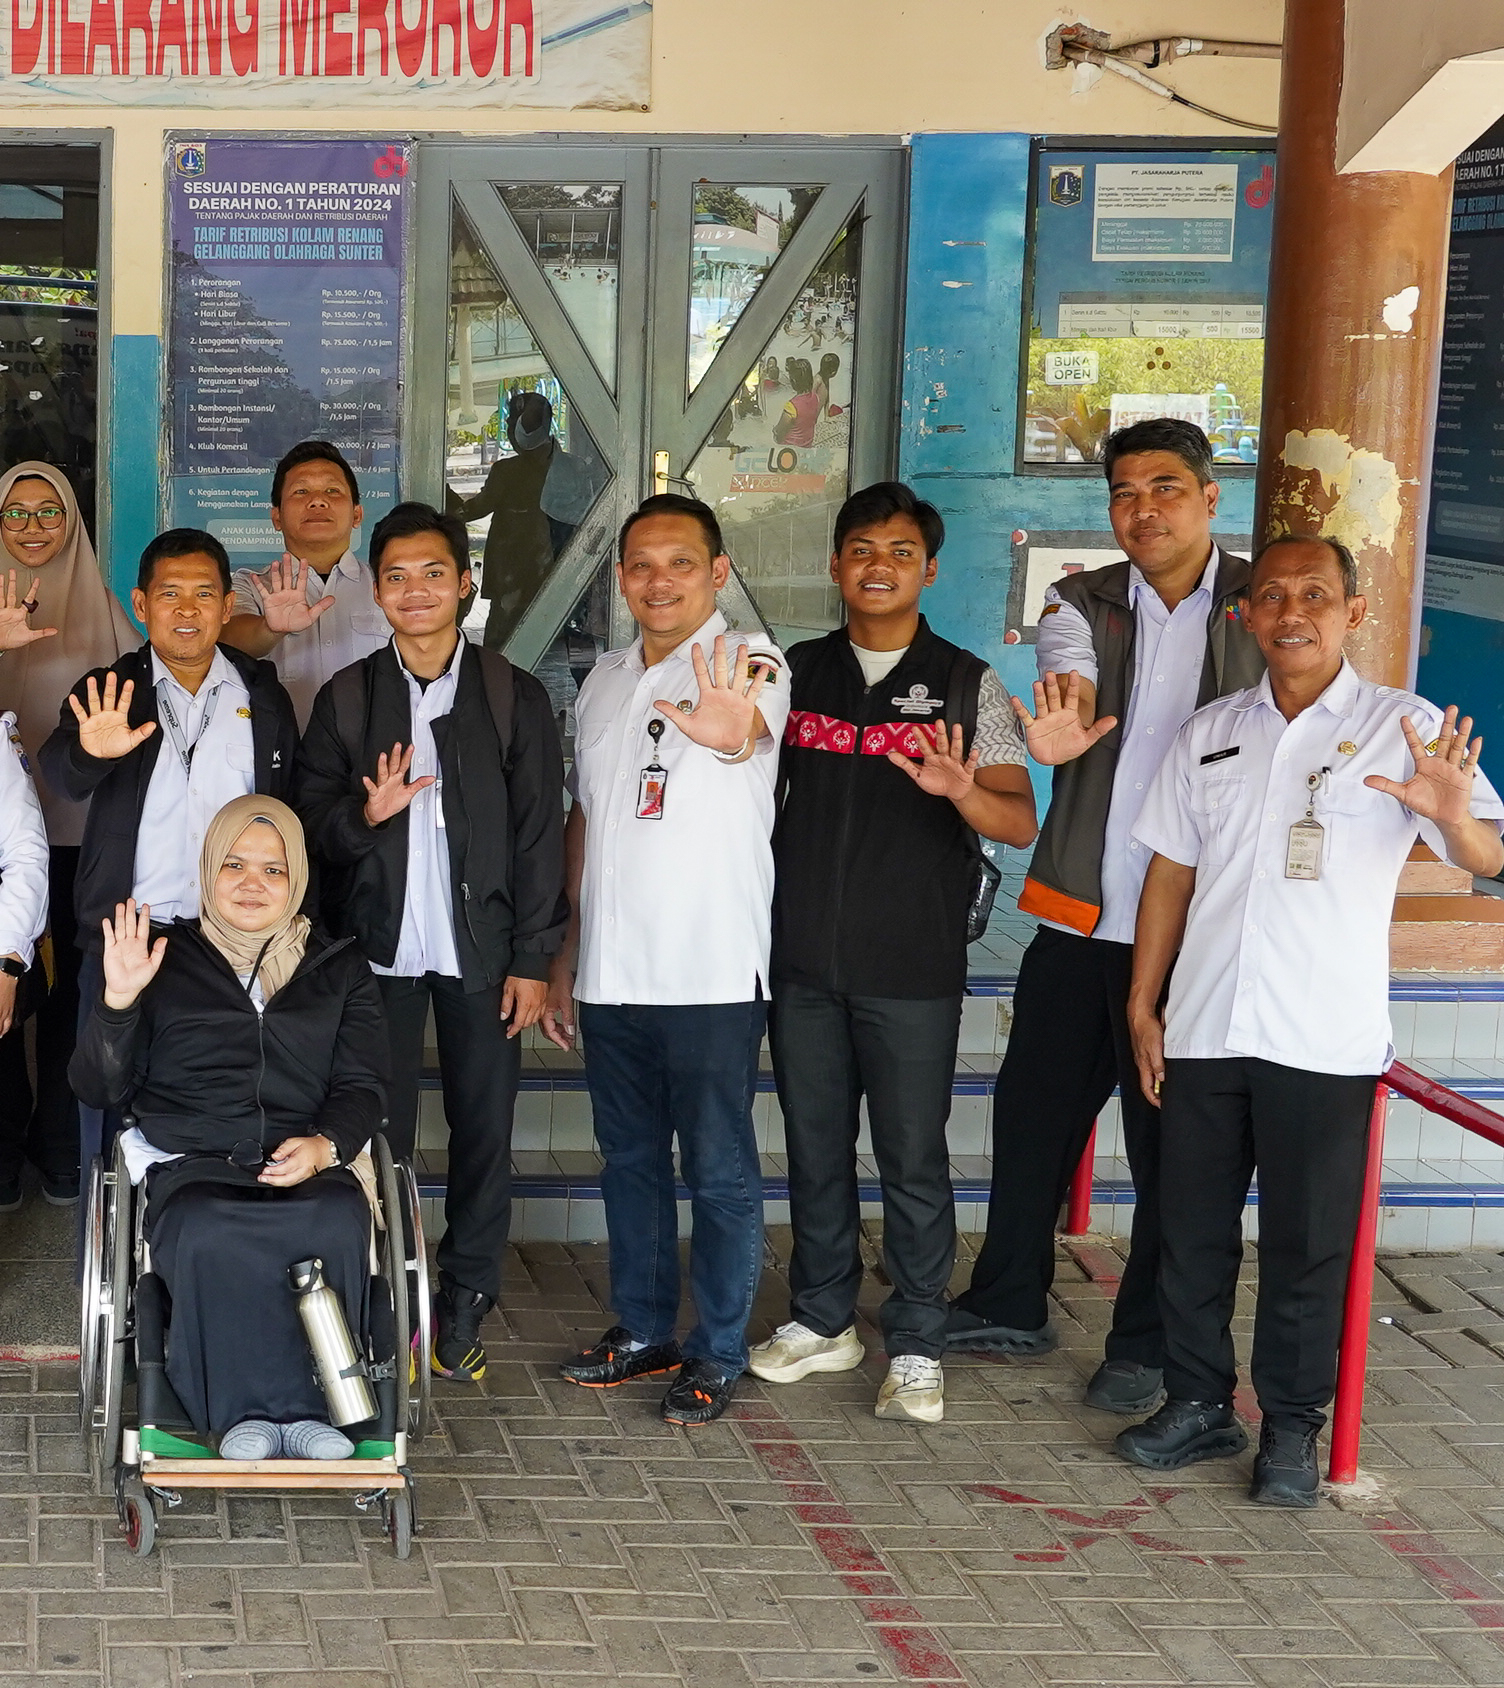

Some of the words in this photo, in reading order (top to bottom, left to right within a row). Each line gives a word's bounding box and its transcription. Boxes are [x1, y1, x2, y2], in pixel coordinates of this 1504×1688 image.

[183, 182, 237, 194] SESUAI
[240, 182, 306, 194] DENGAN
[309, 182, 401, 195] PERATURAN
[189, 198, 251, 210] DAERAH
[255, 198, 282, 210] NO.
[286, 198, 293, 210] 1
[296, 199, 351, 210] TAHUN
[353, 199, 392, 211] 2024
[195, 212, 233, 220] TENTANG
[235, 212, 259, 220] PAJAK
[261, 212, 293, 220] DAERAH
[296, 212, 312, 220] DAN
[194, 227, 226, 242] TARIF
[229, 227, 288, 242] RETRIBUSI
[292, 227, 334, 243] KOLAM
[338, 228, 383, 243] RENANG
[194, 244, 270, 260] GELANGGANG
[274, 244, 335, 260] OLAHRAGA
[339, 245, 383, 260] SUNTER
[198, 279, 241, 288] Perorangan
[322, 289, 333, 298] Rp.
[368, 289, 382, 298] Org
[321, 311, 333, 319] Rp.
[367, 311, 381, 320] Org
[1206, 325, 1218, 333] 500
[190, 337, 197, 345] 2.
[198, 337, 239, 346] Langganan
[241, 337, 284, 346] Perorangan
[321, 339, 332, 347] Rp.
[1054, 356, 1090, 367] BUKA
[198, 366, 242, 375] Rombongan
[321, 367, 332, 375] Rp.
[367, 367, 381, 375] Org
[1054, 369, 1091, 380] OPEN
[198, 378, 236, 386] Perguruan
[238, 377, 260, 386] tinggi
[189, 404, 197, 412] 3.
[197, 404, 241, 413] Rombongan
[320, 402, 331, 411] Rp.
[368, 403, 381, 411] Org
[197, 416, 250, 425] Kantor/Umum
[221, 466, 271, 475] Pertandingan
[197, 489, 230, 497] Kegiatan
[231, 489, 259, 498] dengan
[371, 490, 376, 498] 2
[197, 501, 249, 510] Menggunakan
